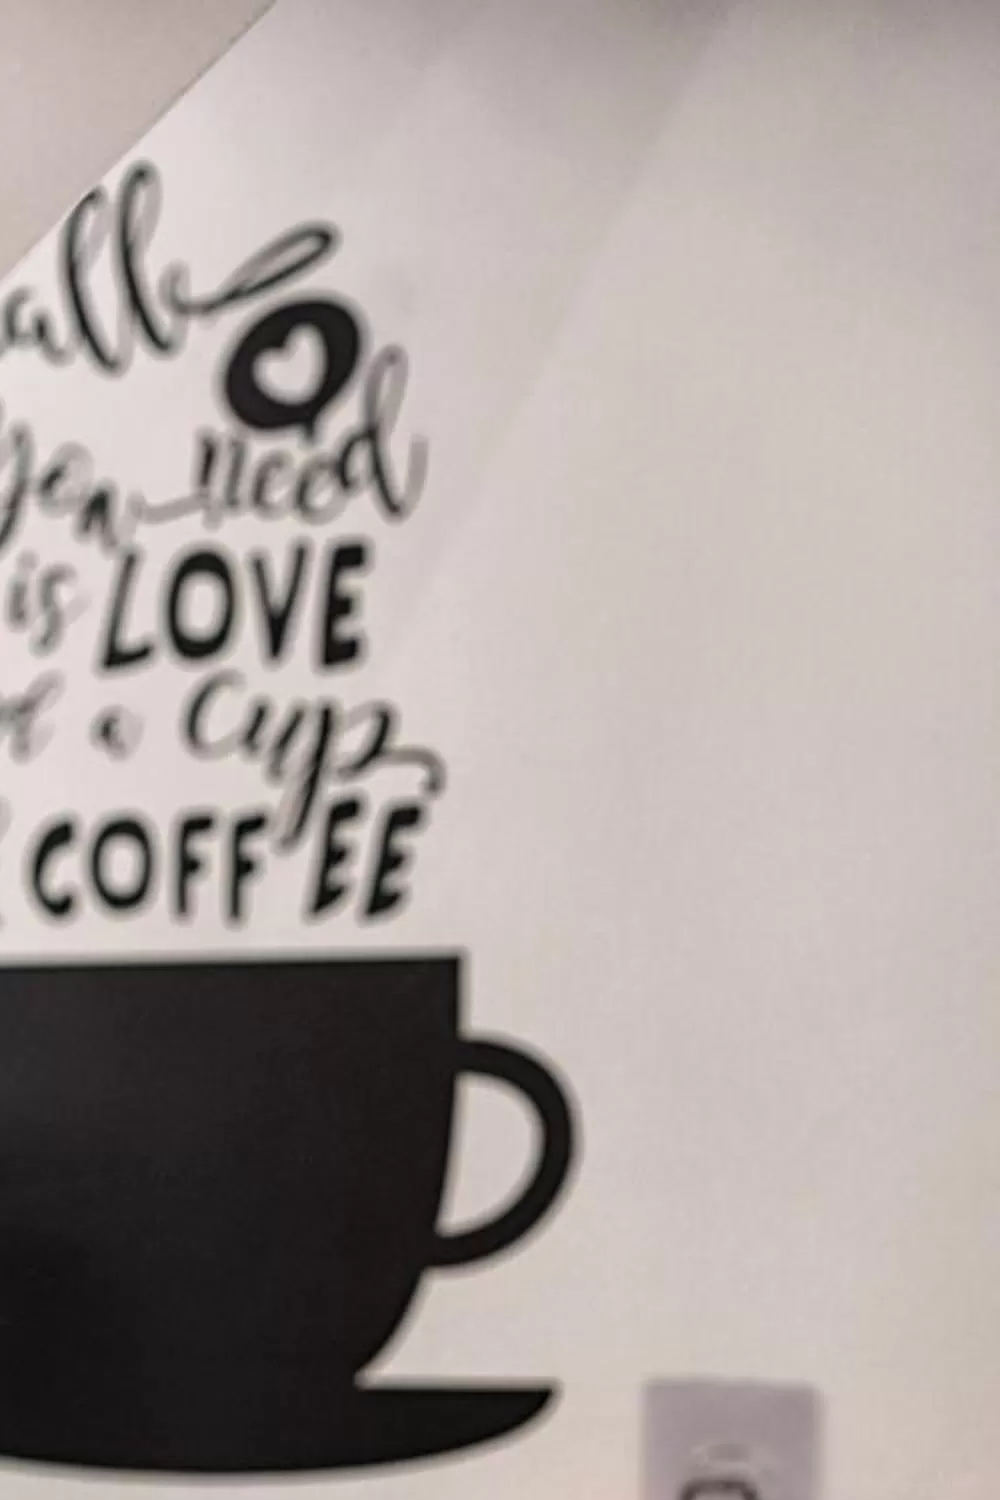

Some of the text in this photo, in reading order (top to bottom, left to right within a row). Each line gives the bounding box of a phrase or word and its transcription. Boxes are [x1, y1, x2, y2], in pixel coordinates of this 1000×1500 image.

[176, 343, 428, 528] need
[5, 534, 376, 674] is LOVE
[21, 796, 430, 929] COFFEE
